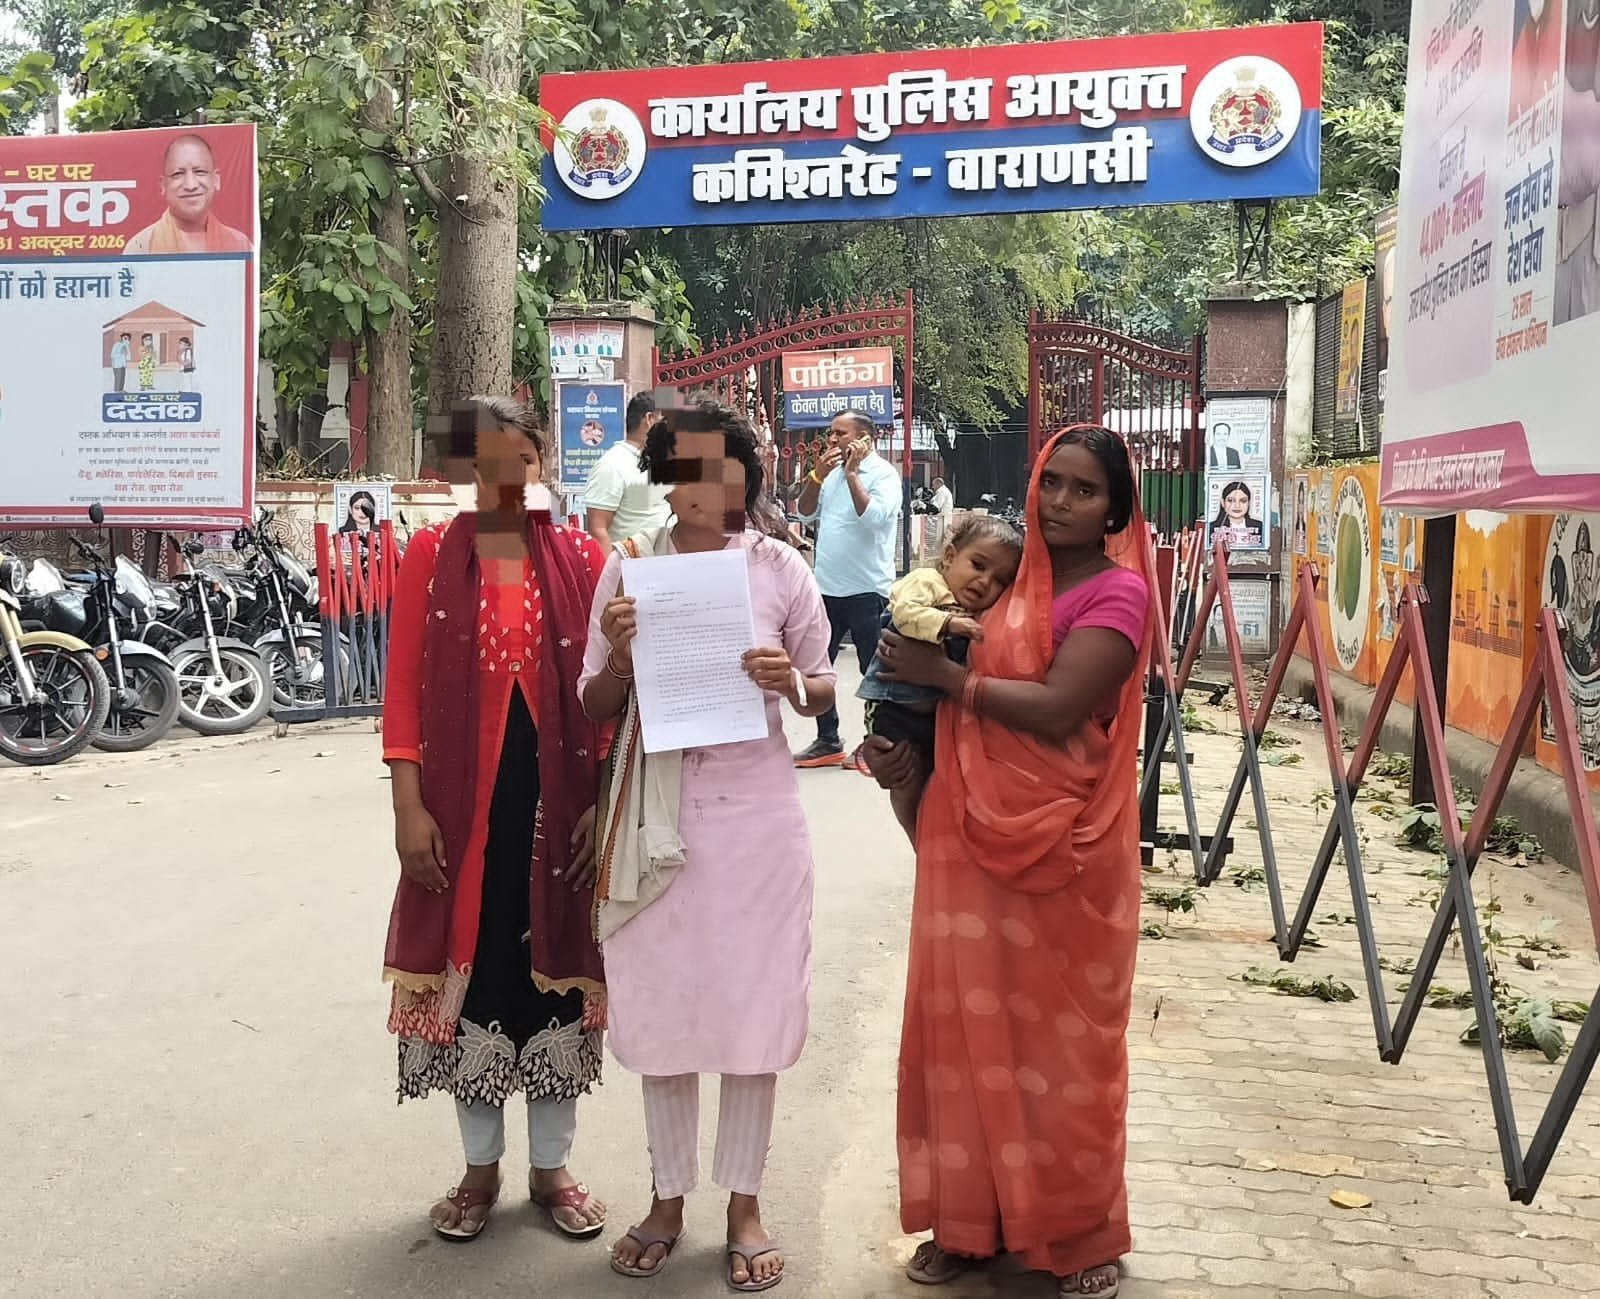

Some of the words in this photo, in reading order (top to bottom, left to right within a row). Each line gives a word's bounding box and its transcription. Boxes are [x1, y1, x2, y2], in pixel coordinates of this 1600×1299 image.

[648, 81, 842, 138] कार्यालय
[851, 68, 993, 142] पुलिस
[1005, 64, 1187, 128] आयुक्त
[26, 165, 59, 181] घर
[62, 163, 95, 180] पर
[692, 144, 902, 203] कमिश्नरेट
[945, 126, 1153, 191] वाराणसी
[1504, 183, 1521, 230] जन
[1522, 162, 1543, 222] सेवा
[1543, 146, 1554, 209] से
[88, 235, 125, 249] 2026
[1507, 231, 1523, 286] देश
[1524, 219, 1545, 275] सेवा
[18, 270, 47, 299] को
[53, 276, 112, 298] हराना
[118, 267, 135, 297] है
[789, 356, 886, 388] पार्किंग
[105, 402, 199, 420] दस्तक
[790, 394, 818, 414] केवल
[820, 392, 848, 417] पुलिस
[850, 395, 867, 410] बल
[869, 389, 885, 414] हेतु
